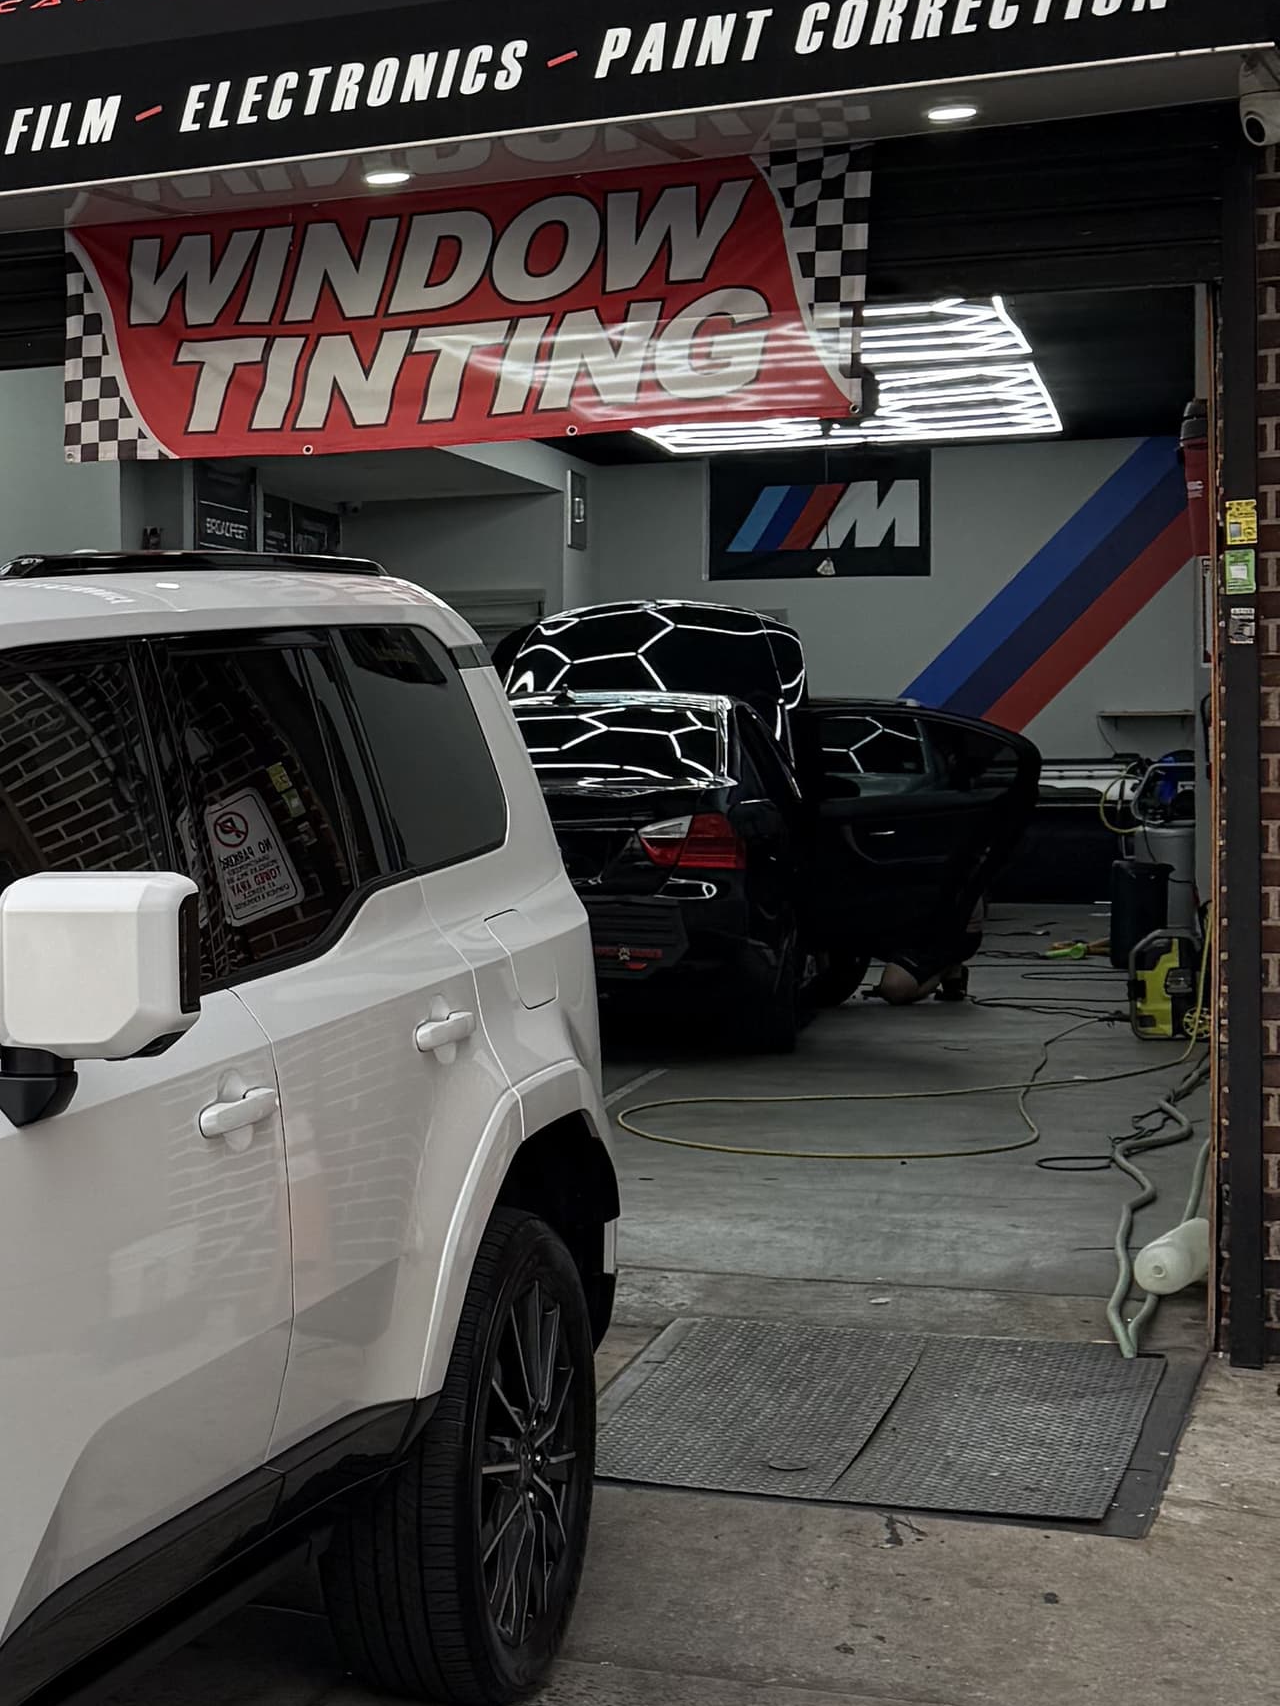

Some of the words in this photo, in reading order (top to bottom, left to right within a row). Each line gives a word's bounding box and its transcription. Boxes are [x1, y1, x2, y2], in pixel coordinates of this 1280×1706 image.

[5, 95, 122, 154] FILM
[179, 40, 528, 133] ELECTRONICS
[595, 8, 773, 79] PAINT
[125, 177, 758, 329] WINDOW
[173, 286, 771, 434] TINTING
